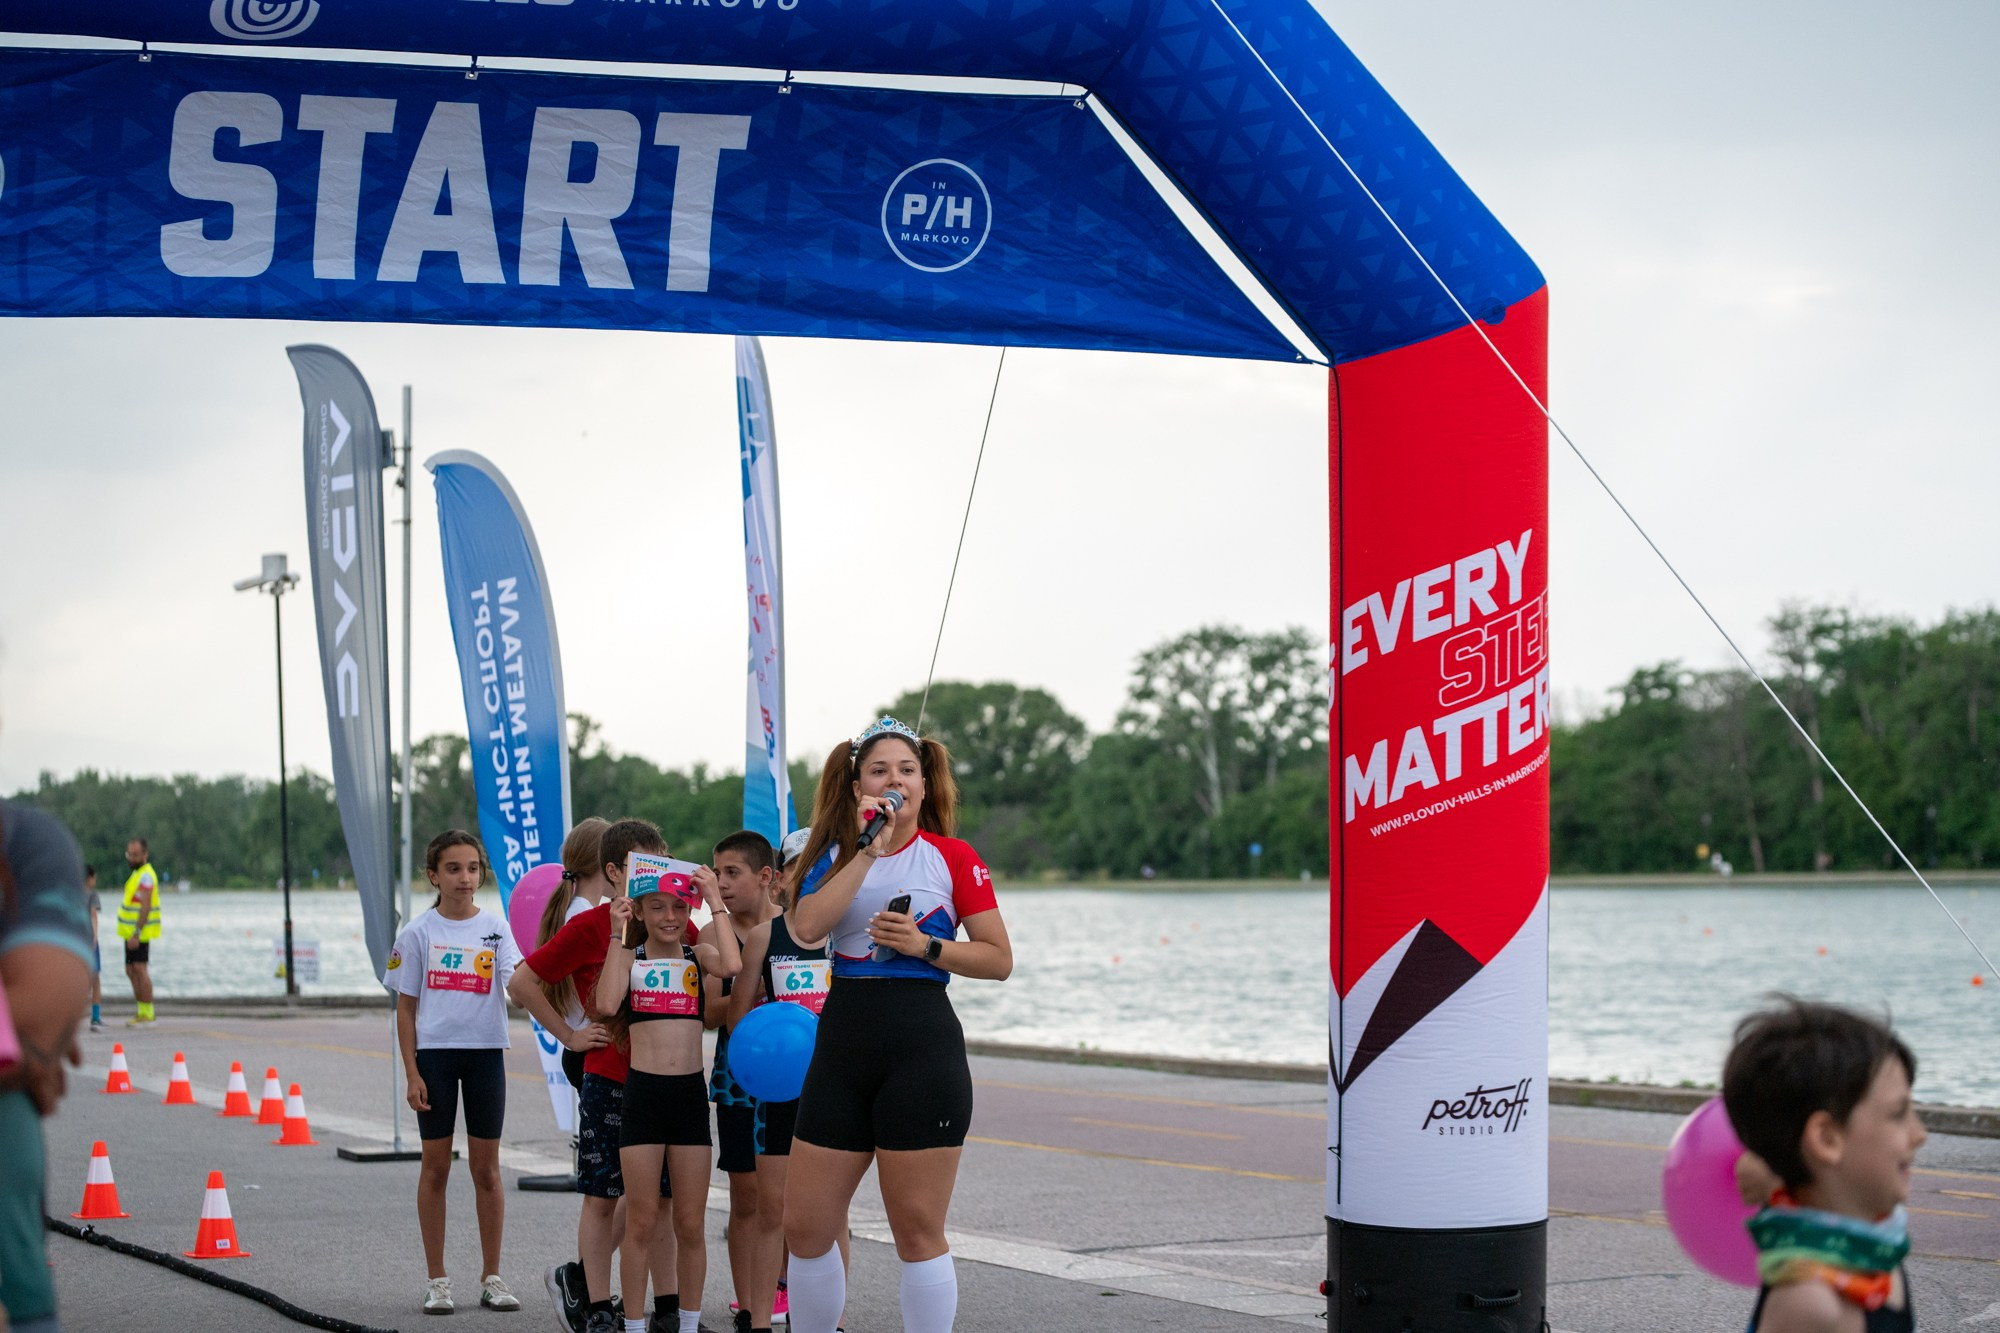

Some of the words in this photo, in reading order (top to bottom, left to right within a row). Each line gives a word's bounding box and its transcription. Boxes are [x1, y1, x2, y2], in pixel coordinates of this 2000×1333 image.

[159, 90, 752, 293] START
[932, 181, 947, 190] IN
[901, 193, 973, 230] P/H
[900, 232, 970, 245] MARKOVO
[1342, 528, 1532, 676] EVERY
[440, 953, 463, 969] 47
[644, 968, 670, 988] 61
[785, 970, 814, 991] 62
[1439, 1125, 1493, 1136] STUDIO
